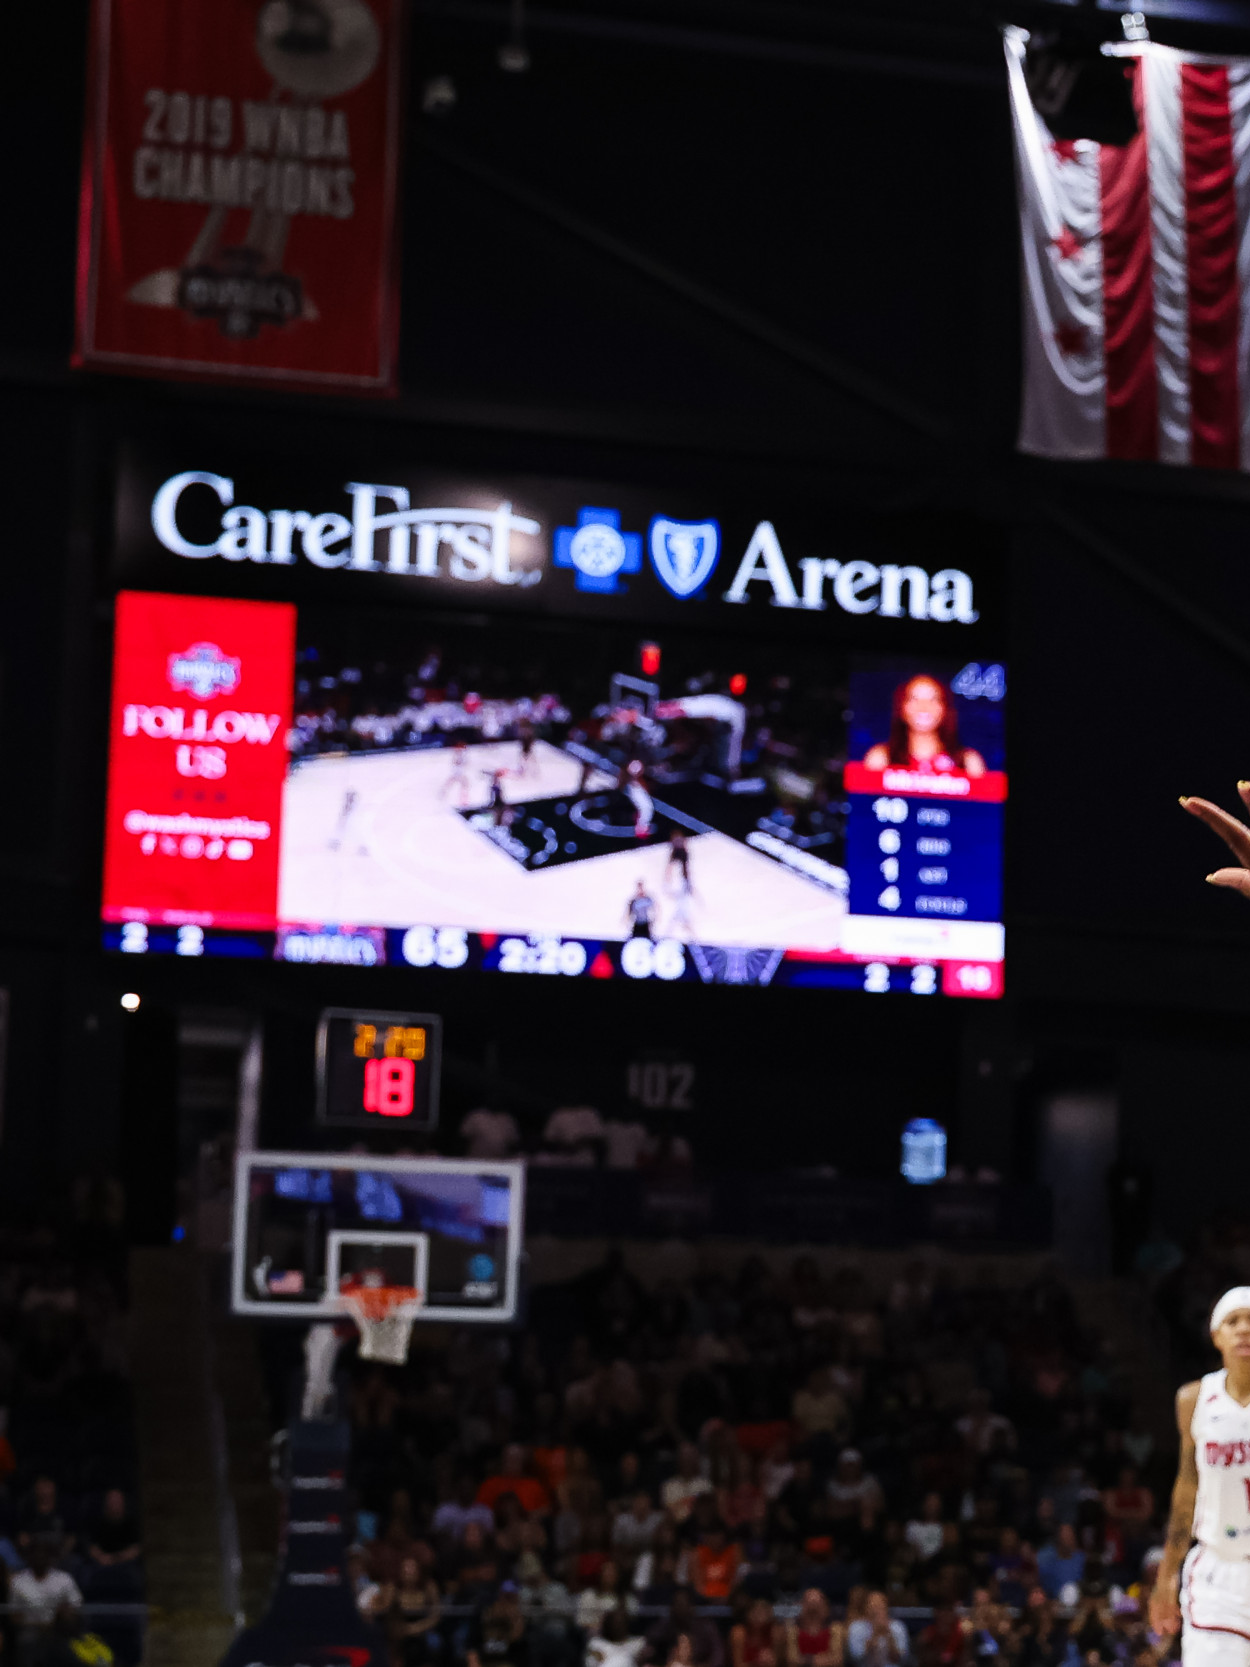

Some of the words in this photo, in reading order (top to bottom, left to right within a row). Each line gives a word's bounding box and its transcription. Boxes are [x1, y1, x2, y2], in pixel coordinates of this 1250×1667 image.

[143, 88, 233, 148] 2019
[242, 99, 350, 160] WNBA
[132, 145, 356, 219] CHAMPIONS
[152, 470, 540, 586] CareFirst
[726, 521, 978, 623] Arena
[951, 663, 1006, 701] 44
[124, 704, 280, 743] FOLLOW
[177, 745, 226, 779] US
[121, 922, 148, 953] 2
[176, 924, 203, 956] 2
[402, 926, 469, 968] 65
[621, 938, 685, 980] 66
[864, 962, 890, 993] 2
[910, 964, 937, 994] 2
[363, 1056, 416, 1117] 18
[627, 1062, 694, 1110] 102
